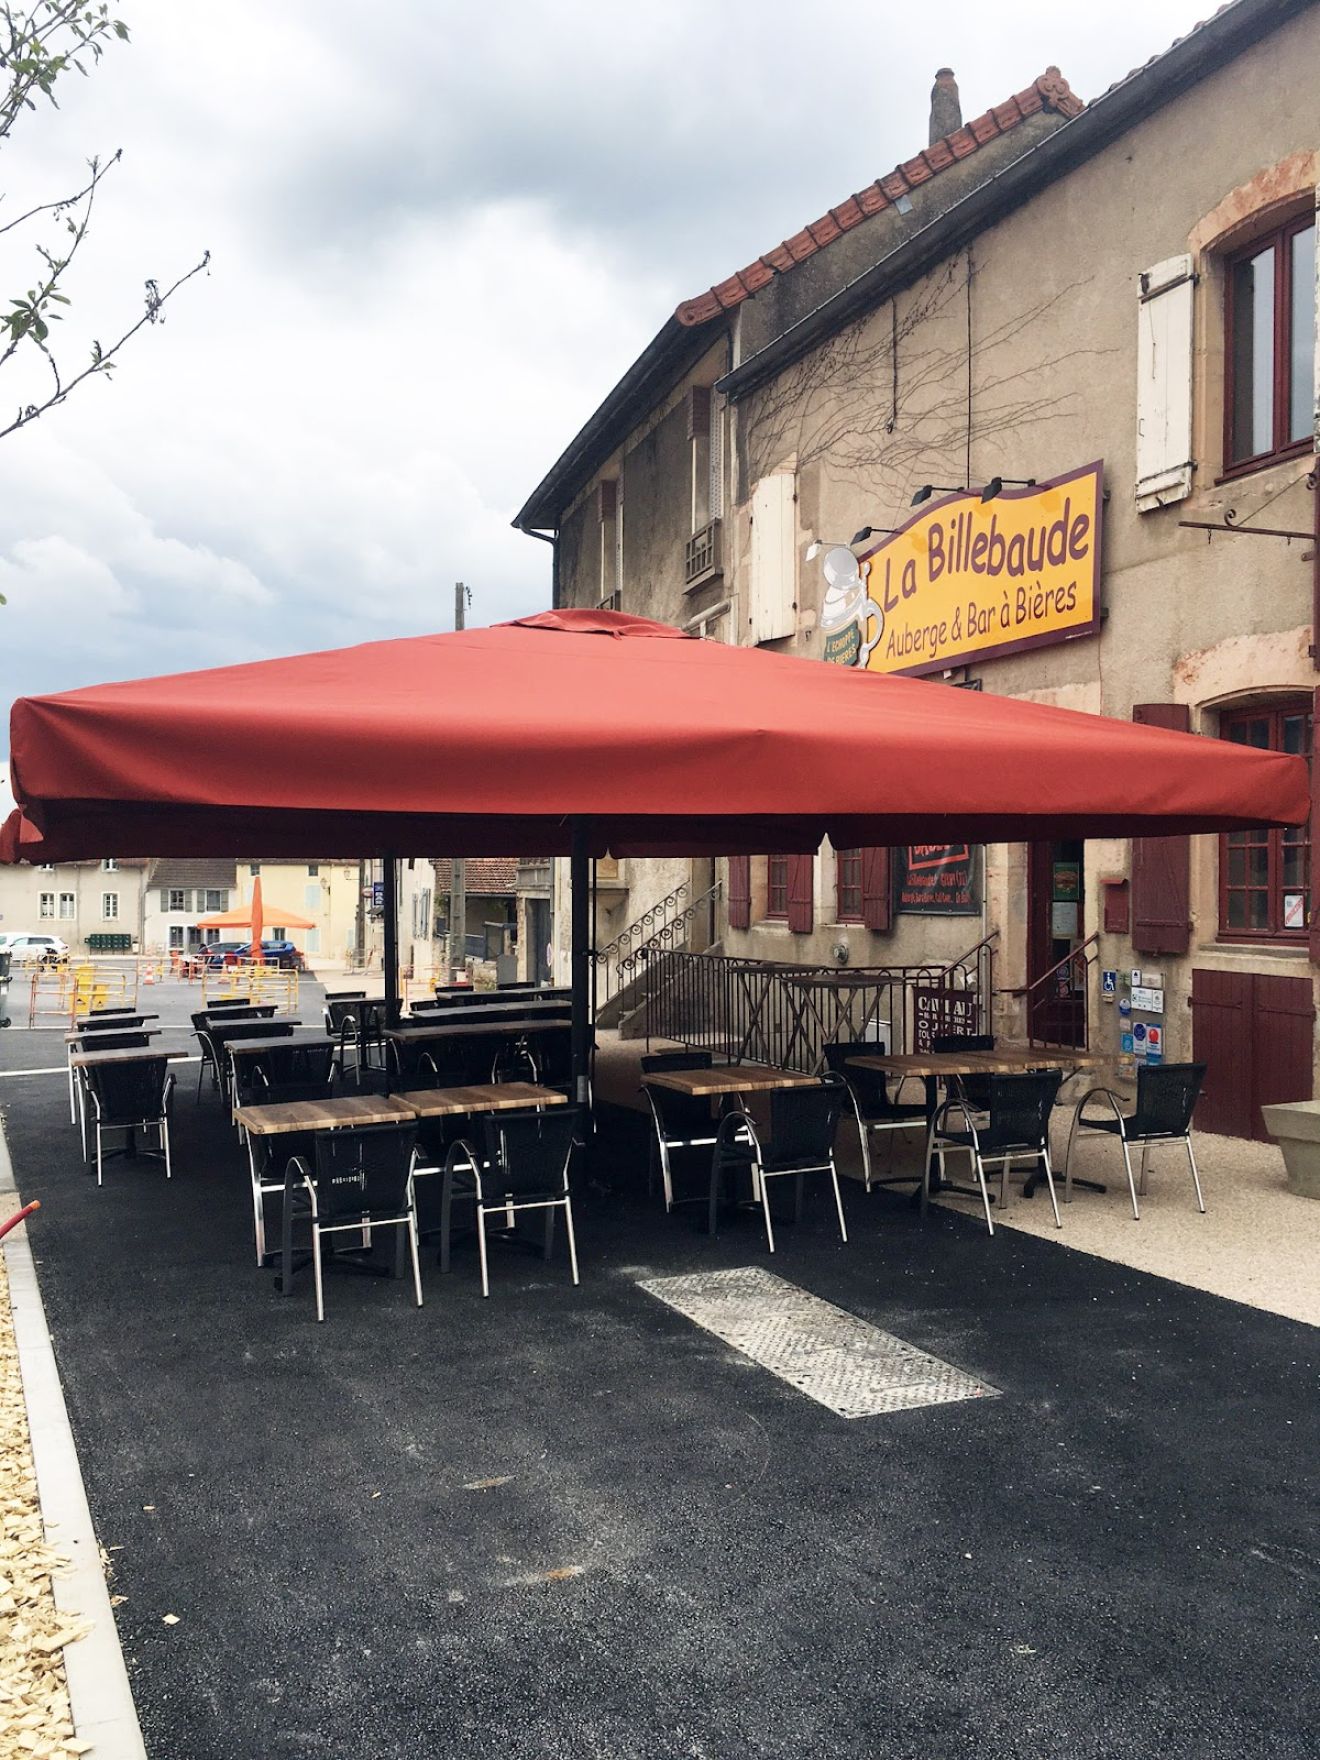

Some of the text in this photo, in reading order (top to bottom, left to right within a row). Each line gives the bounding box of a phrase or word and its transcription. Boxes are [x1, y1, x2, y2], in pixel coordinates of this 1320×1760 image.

[884, 497, 1090, 613] La Billebaude
[886, 580, 1077, 659] Auberge & Bar à Bières
